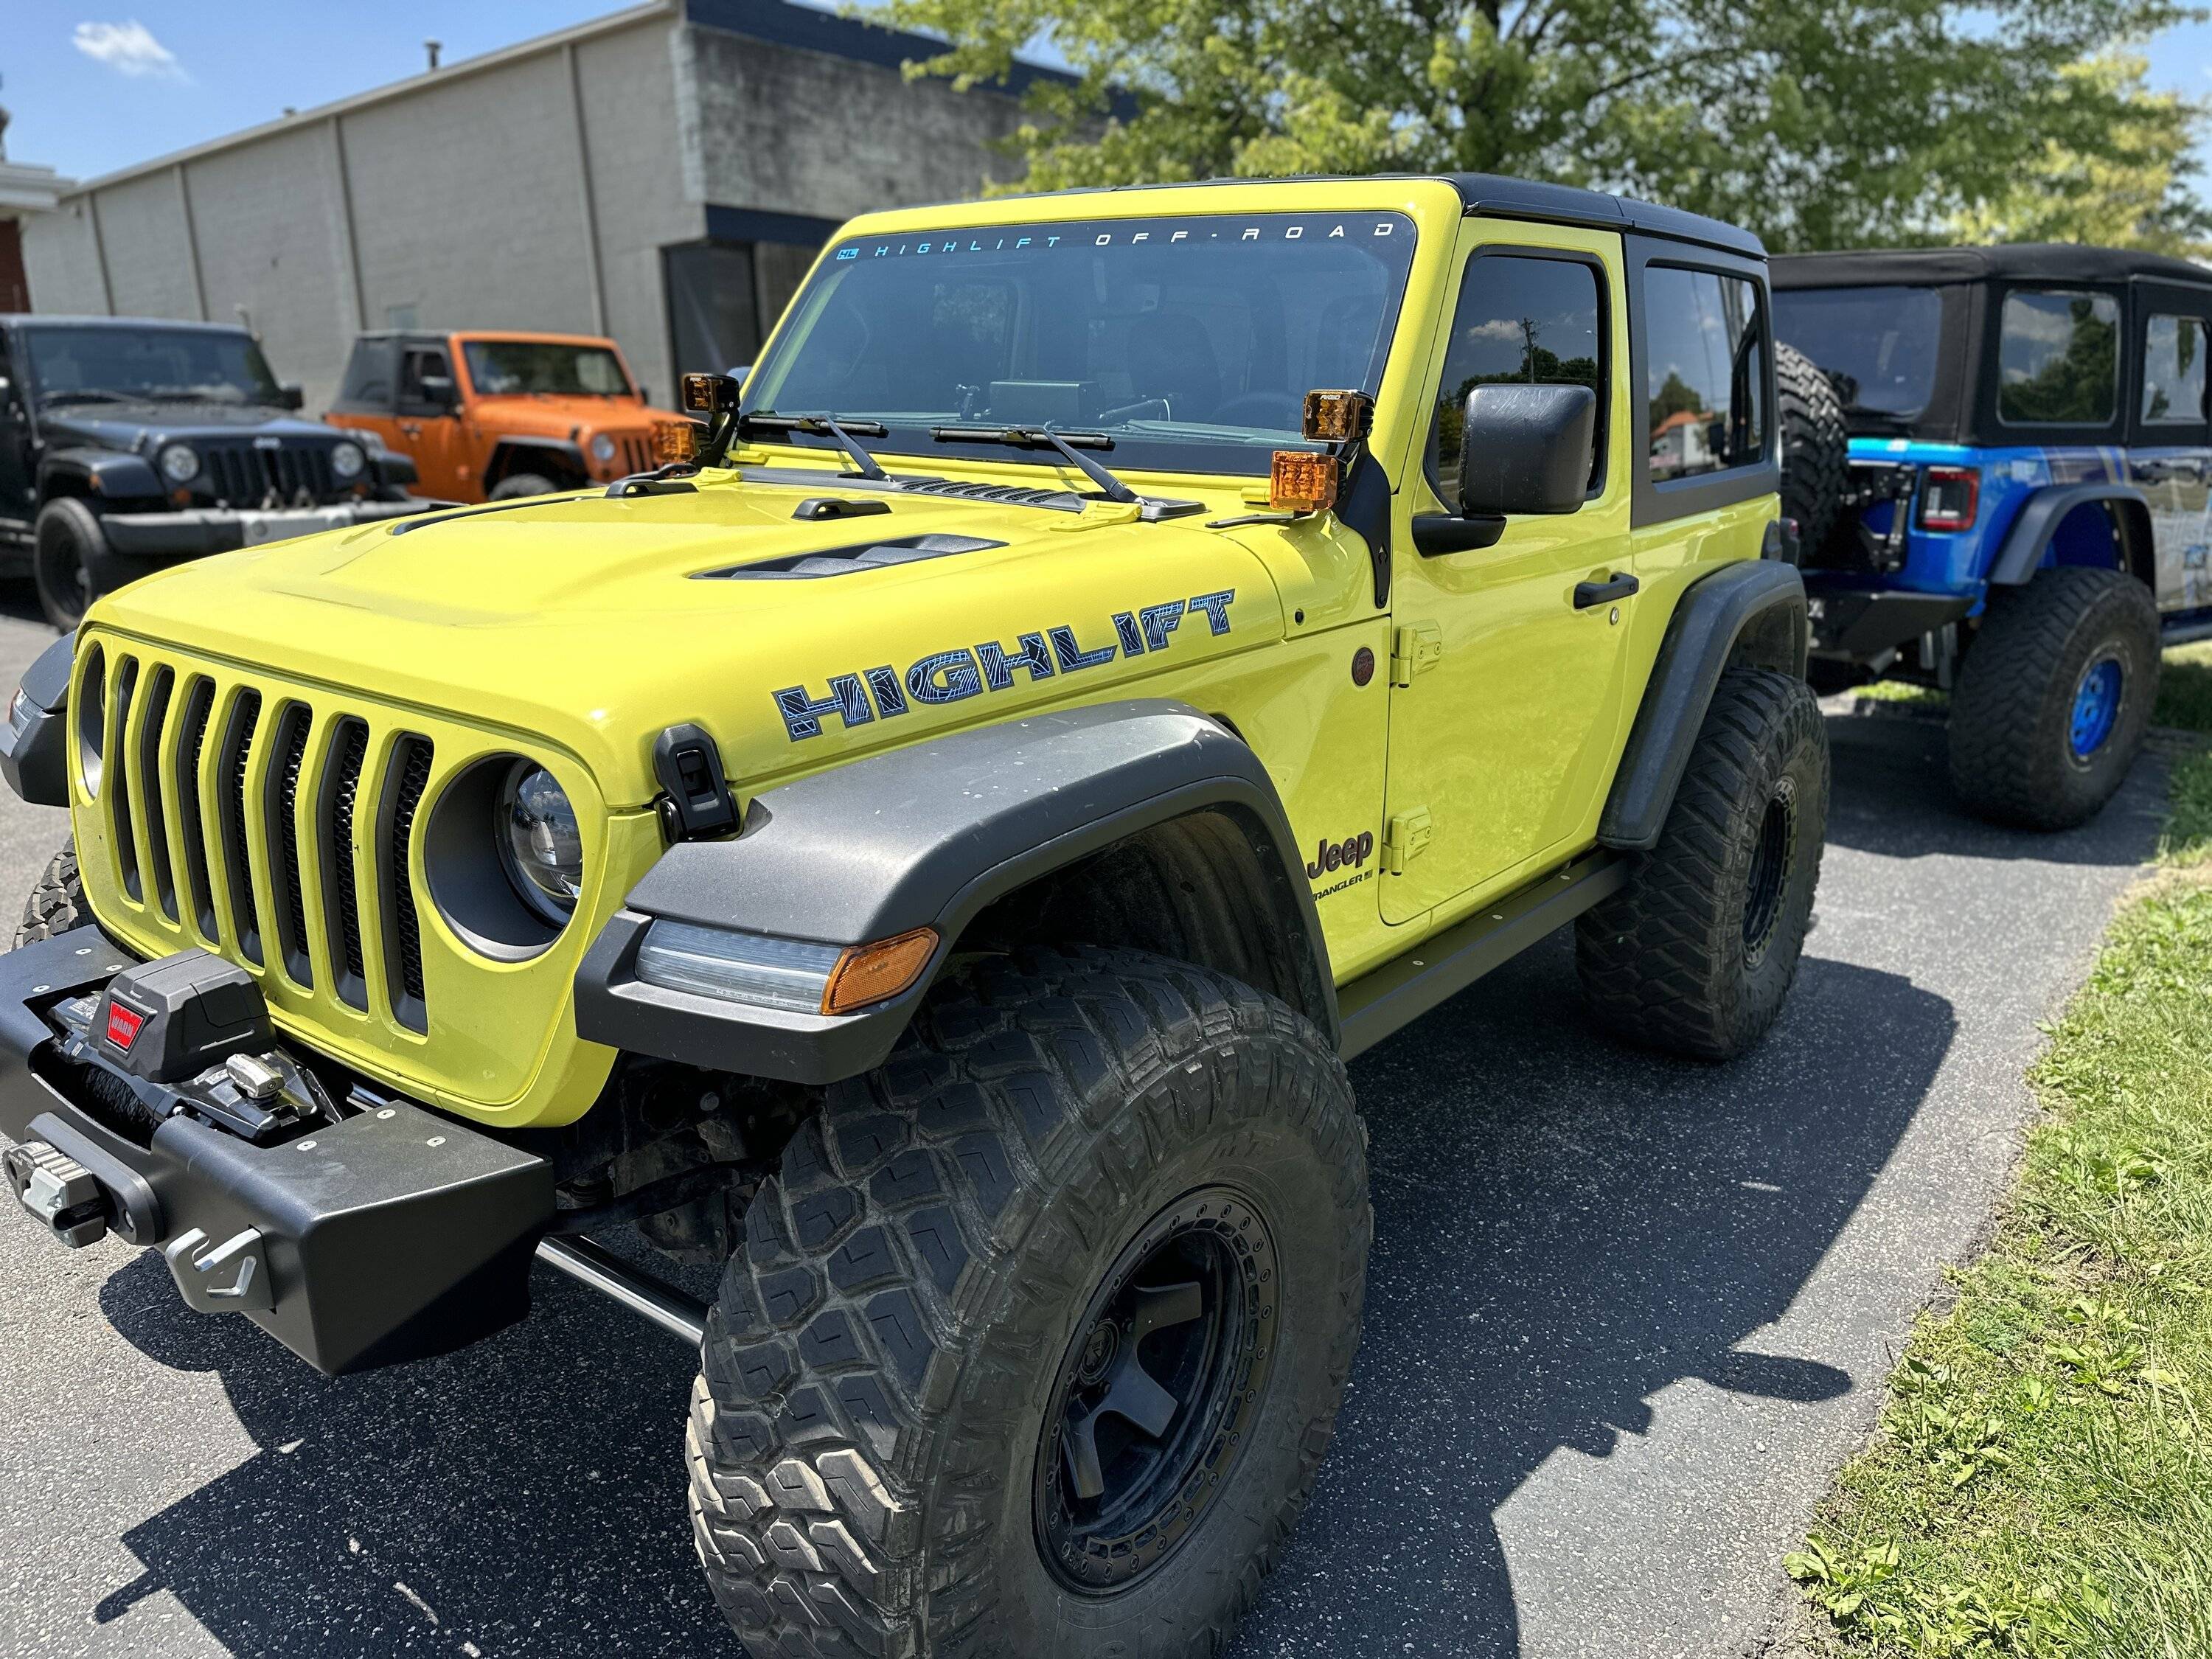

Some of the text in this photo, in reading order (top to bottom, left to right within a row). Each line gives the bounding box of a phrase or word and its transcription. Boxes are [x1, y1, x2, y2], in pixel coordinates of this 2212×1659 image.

[875, 237, 1060, 257] HIGHLIFT
[771, 589, 1235, 742] HIGHLIFT
[1307, 830, 1374, 880] Jeep
[1312, 874, 1363, 901] RANGLER
[111, 1015, 133, 1037] WARN
